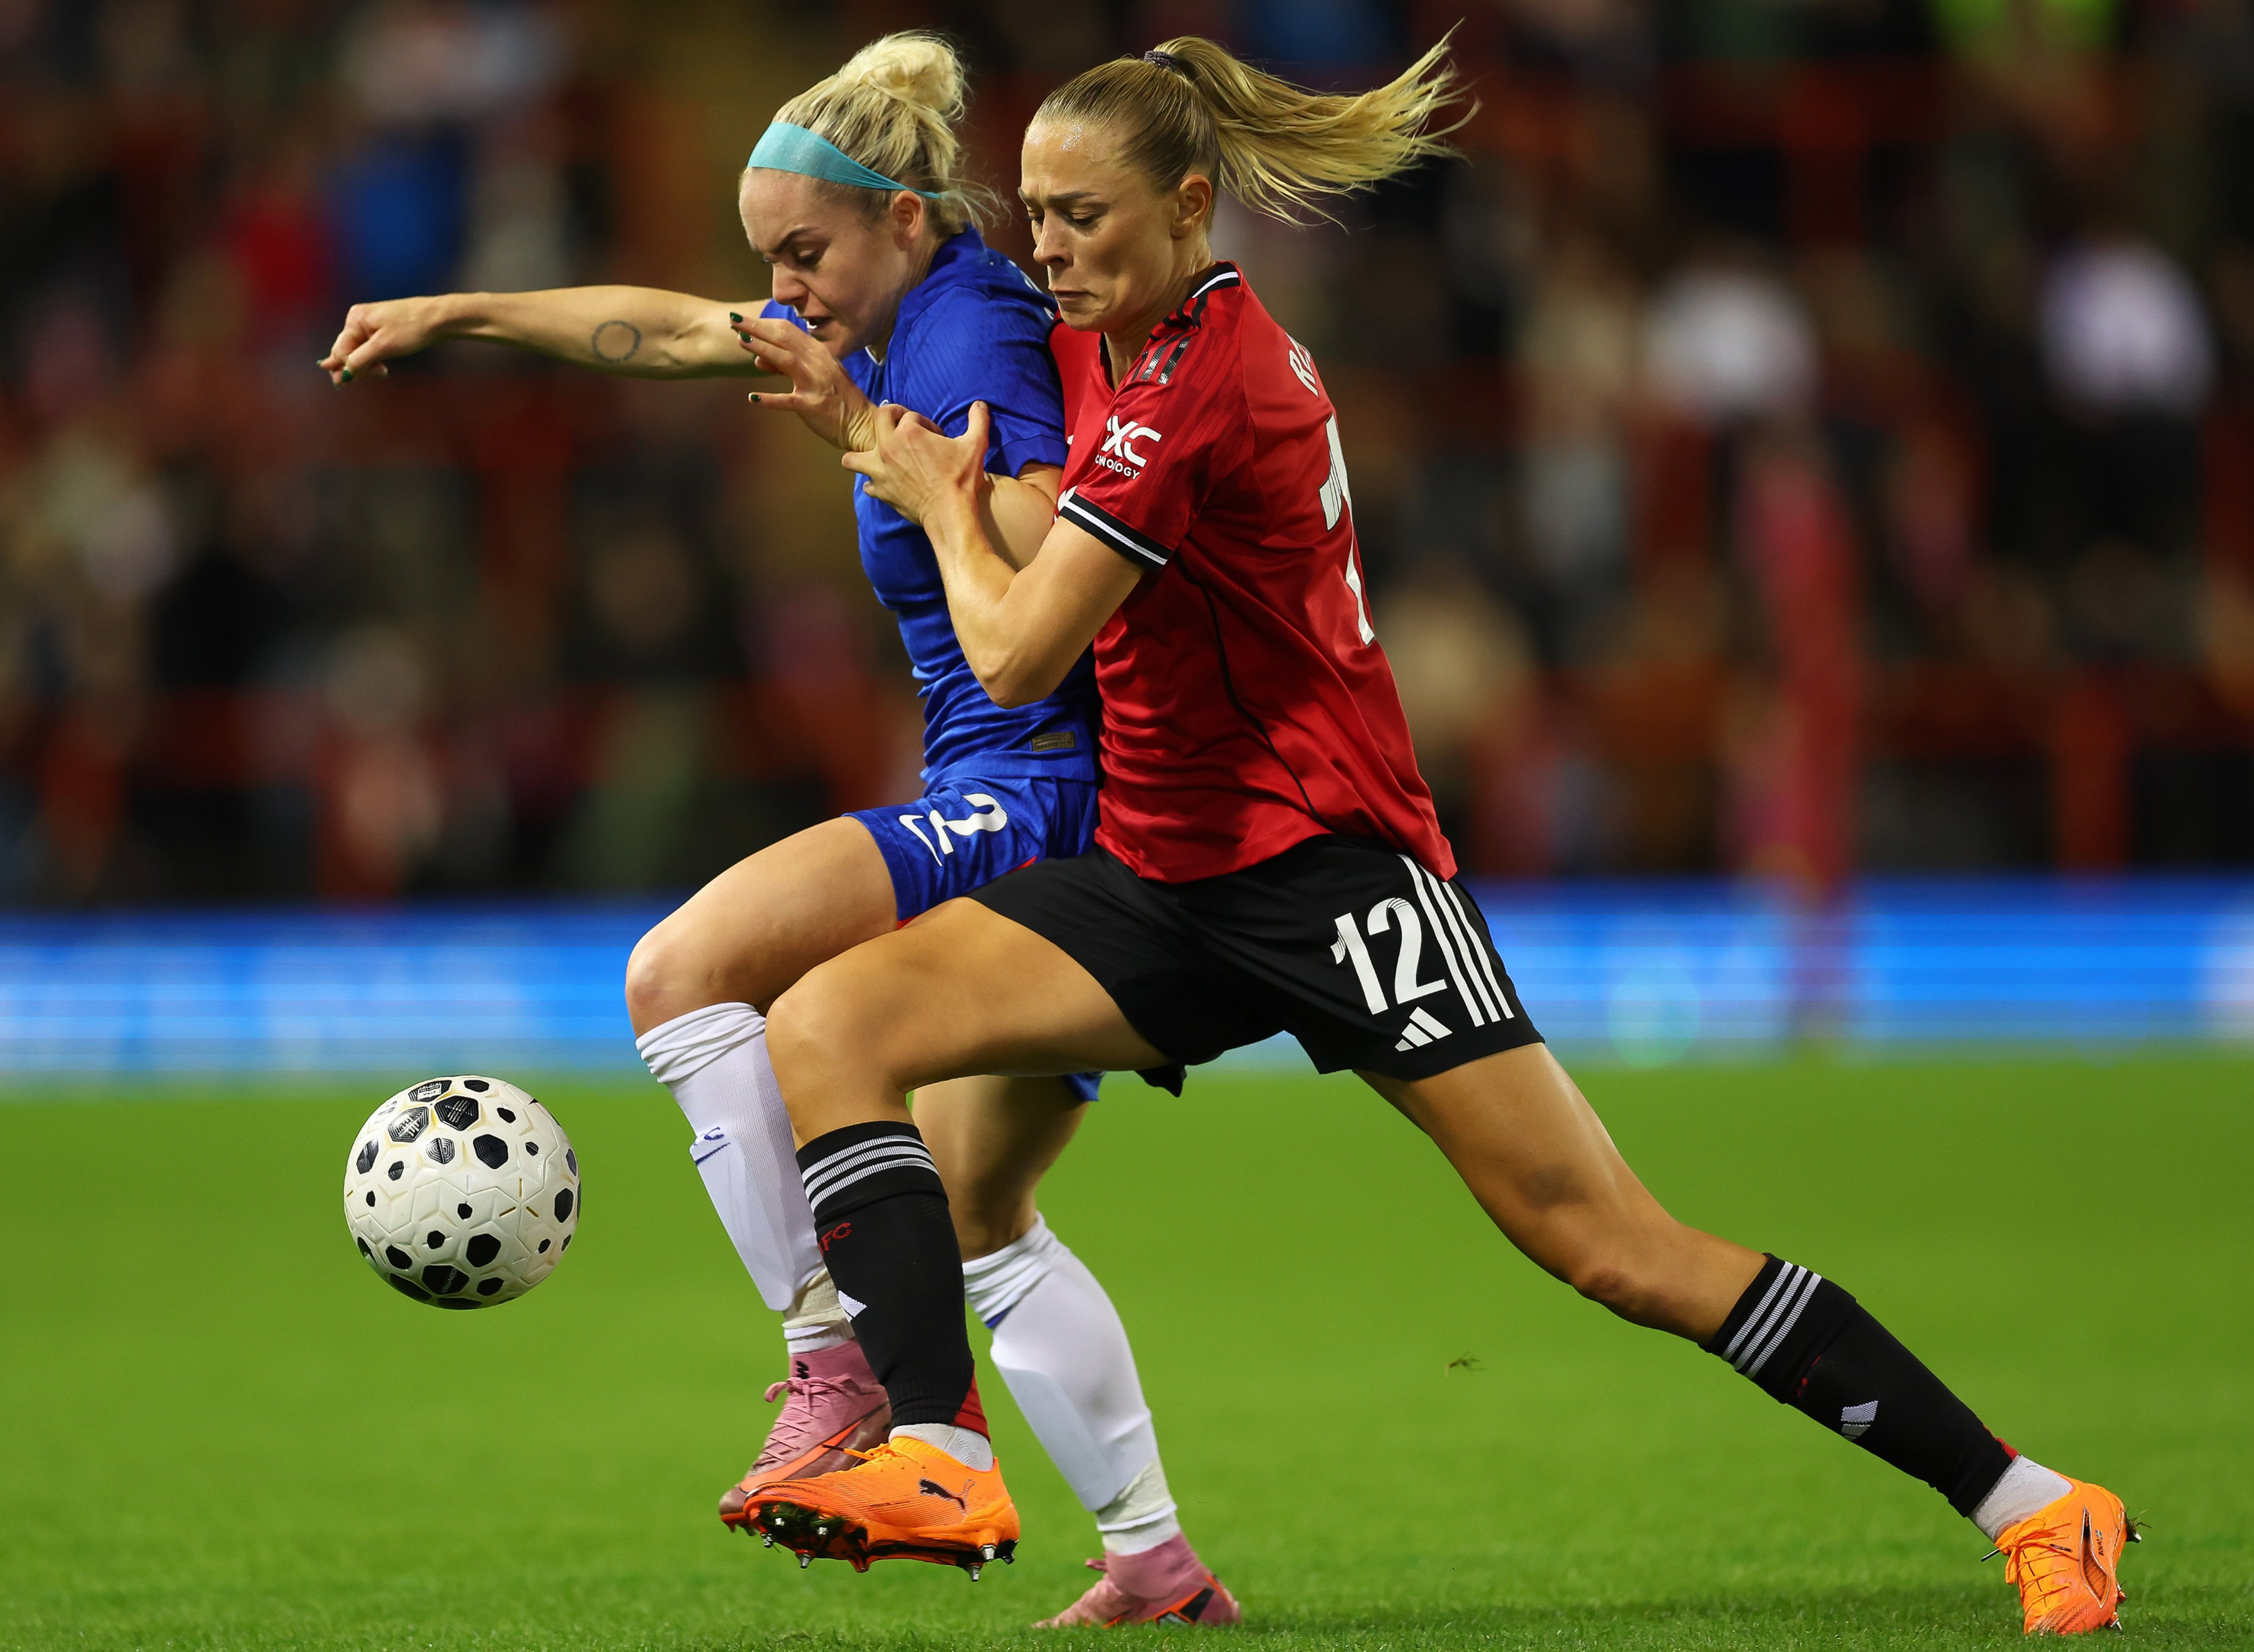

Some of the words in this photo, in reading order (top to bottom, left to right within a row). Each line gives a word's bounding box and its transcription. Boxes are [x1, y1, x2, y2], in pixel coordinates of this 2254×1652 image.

[929, 793, 1008, 855] 2
[1330, 898, 1448, 1015] 12
[818, 1223, 851, 1258] FC
